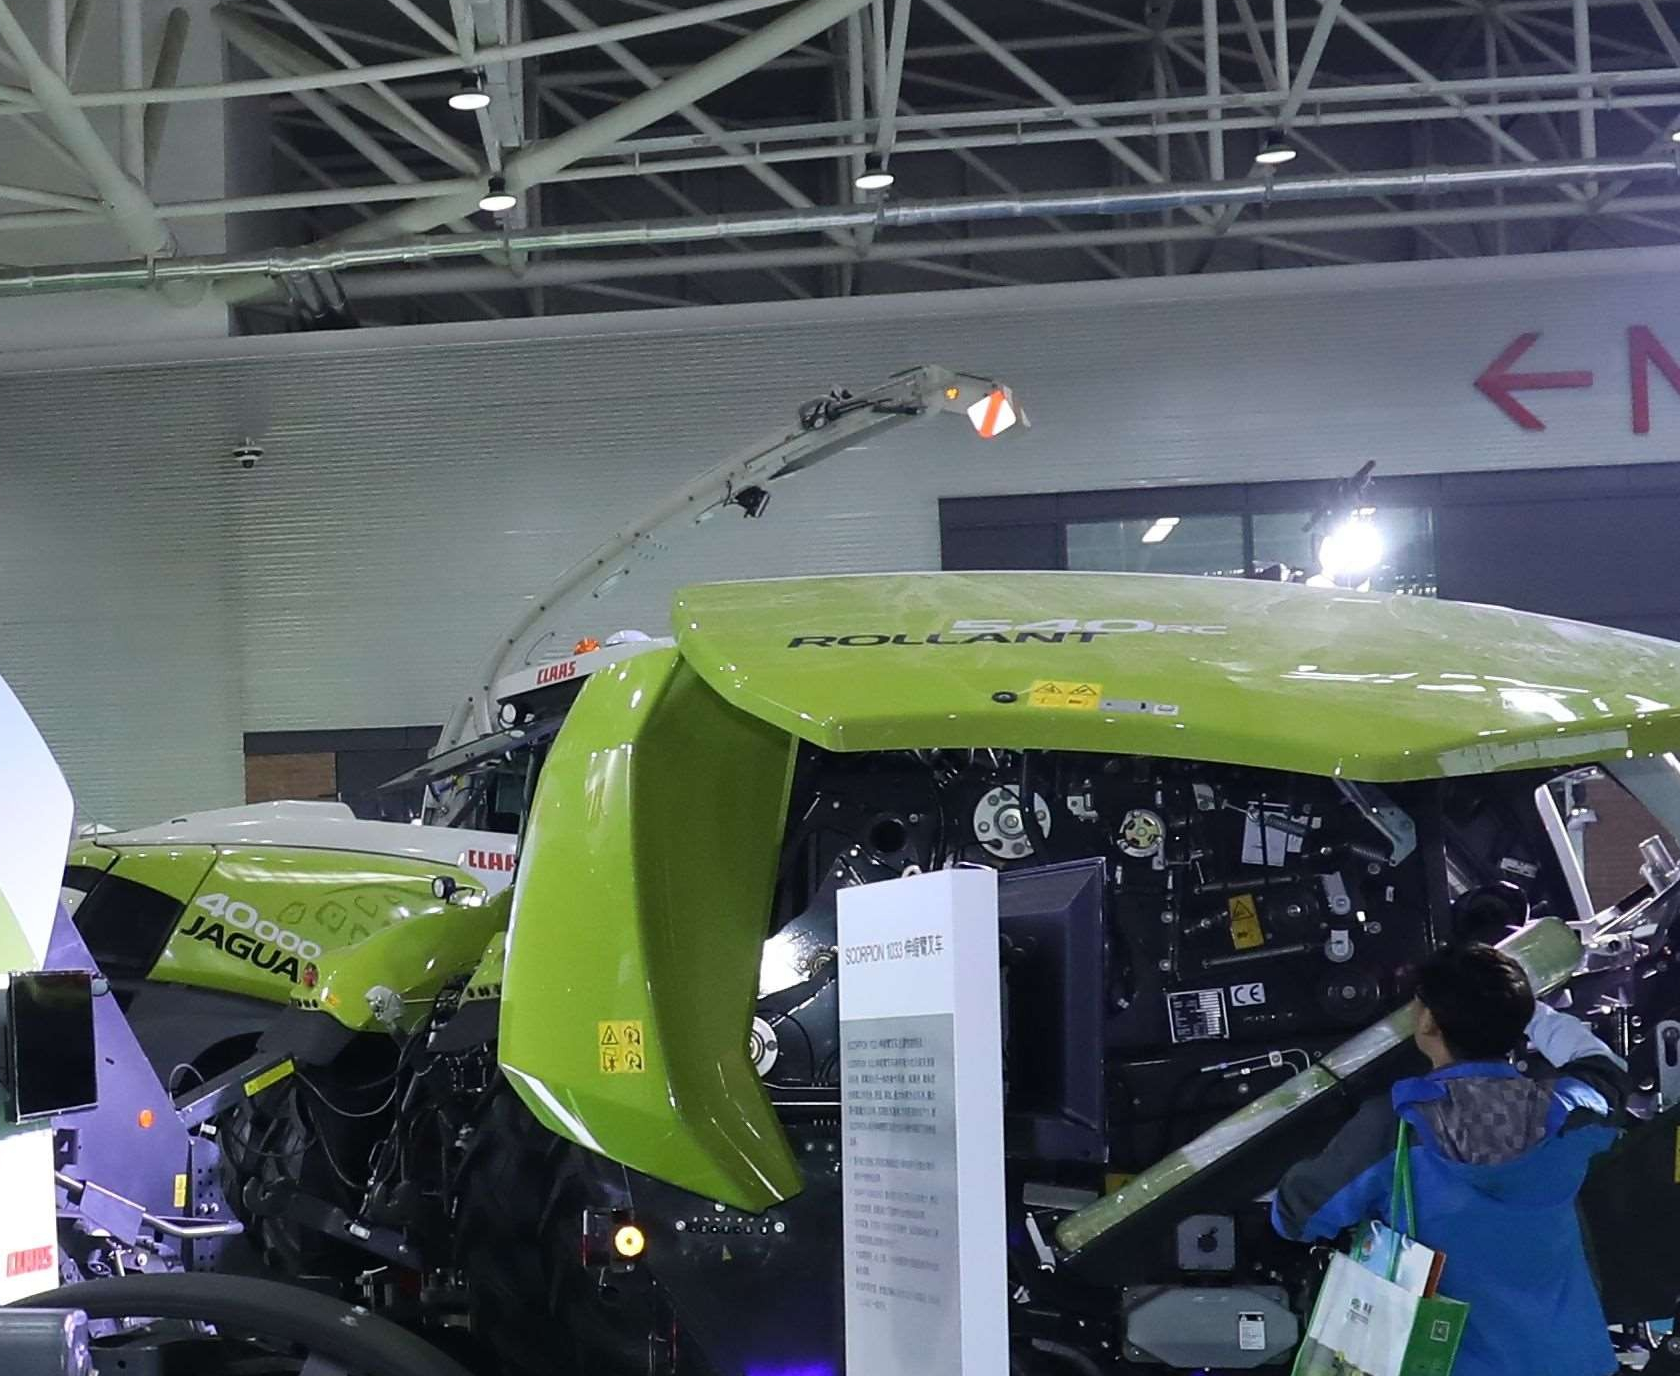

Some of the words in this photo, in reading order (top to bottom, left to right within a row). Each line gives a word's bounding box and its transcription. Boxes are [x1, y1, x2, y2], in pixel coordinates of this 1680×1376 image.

[787, 631, 1109, 648] ROLLANT
[537, 661, 576, 685] CLAAS
[196, 893, 321, 960] 40000
[181, 916, 301, 984] JAGUA
